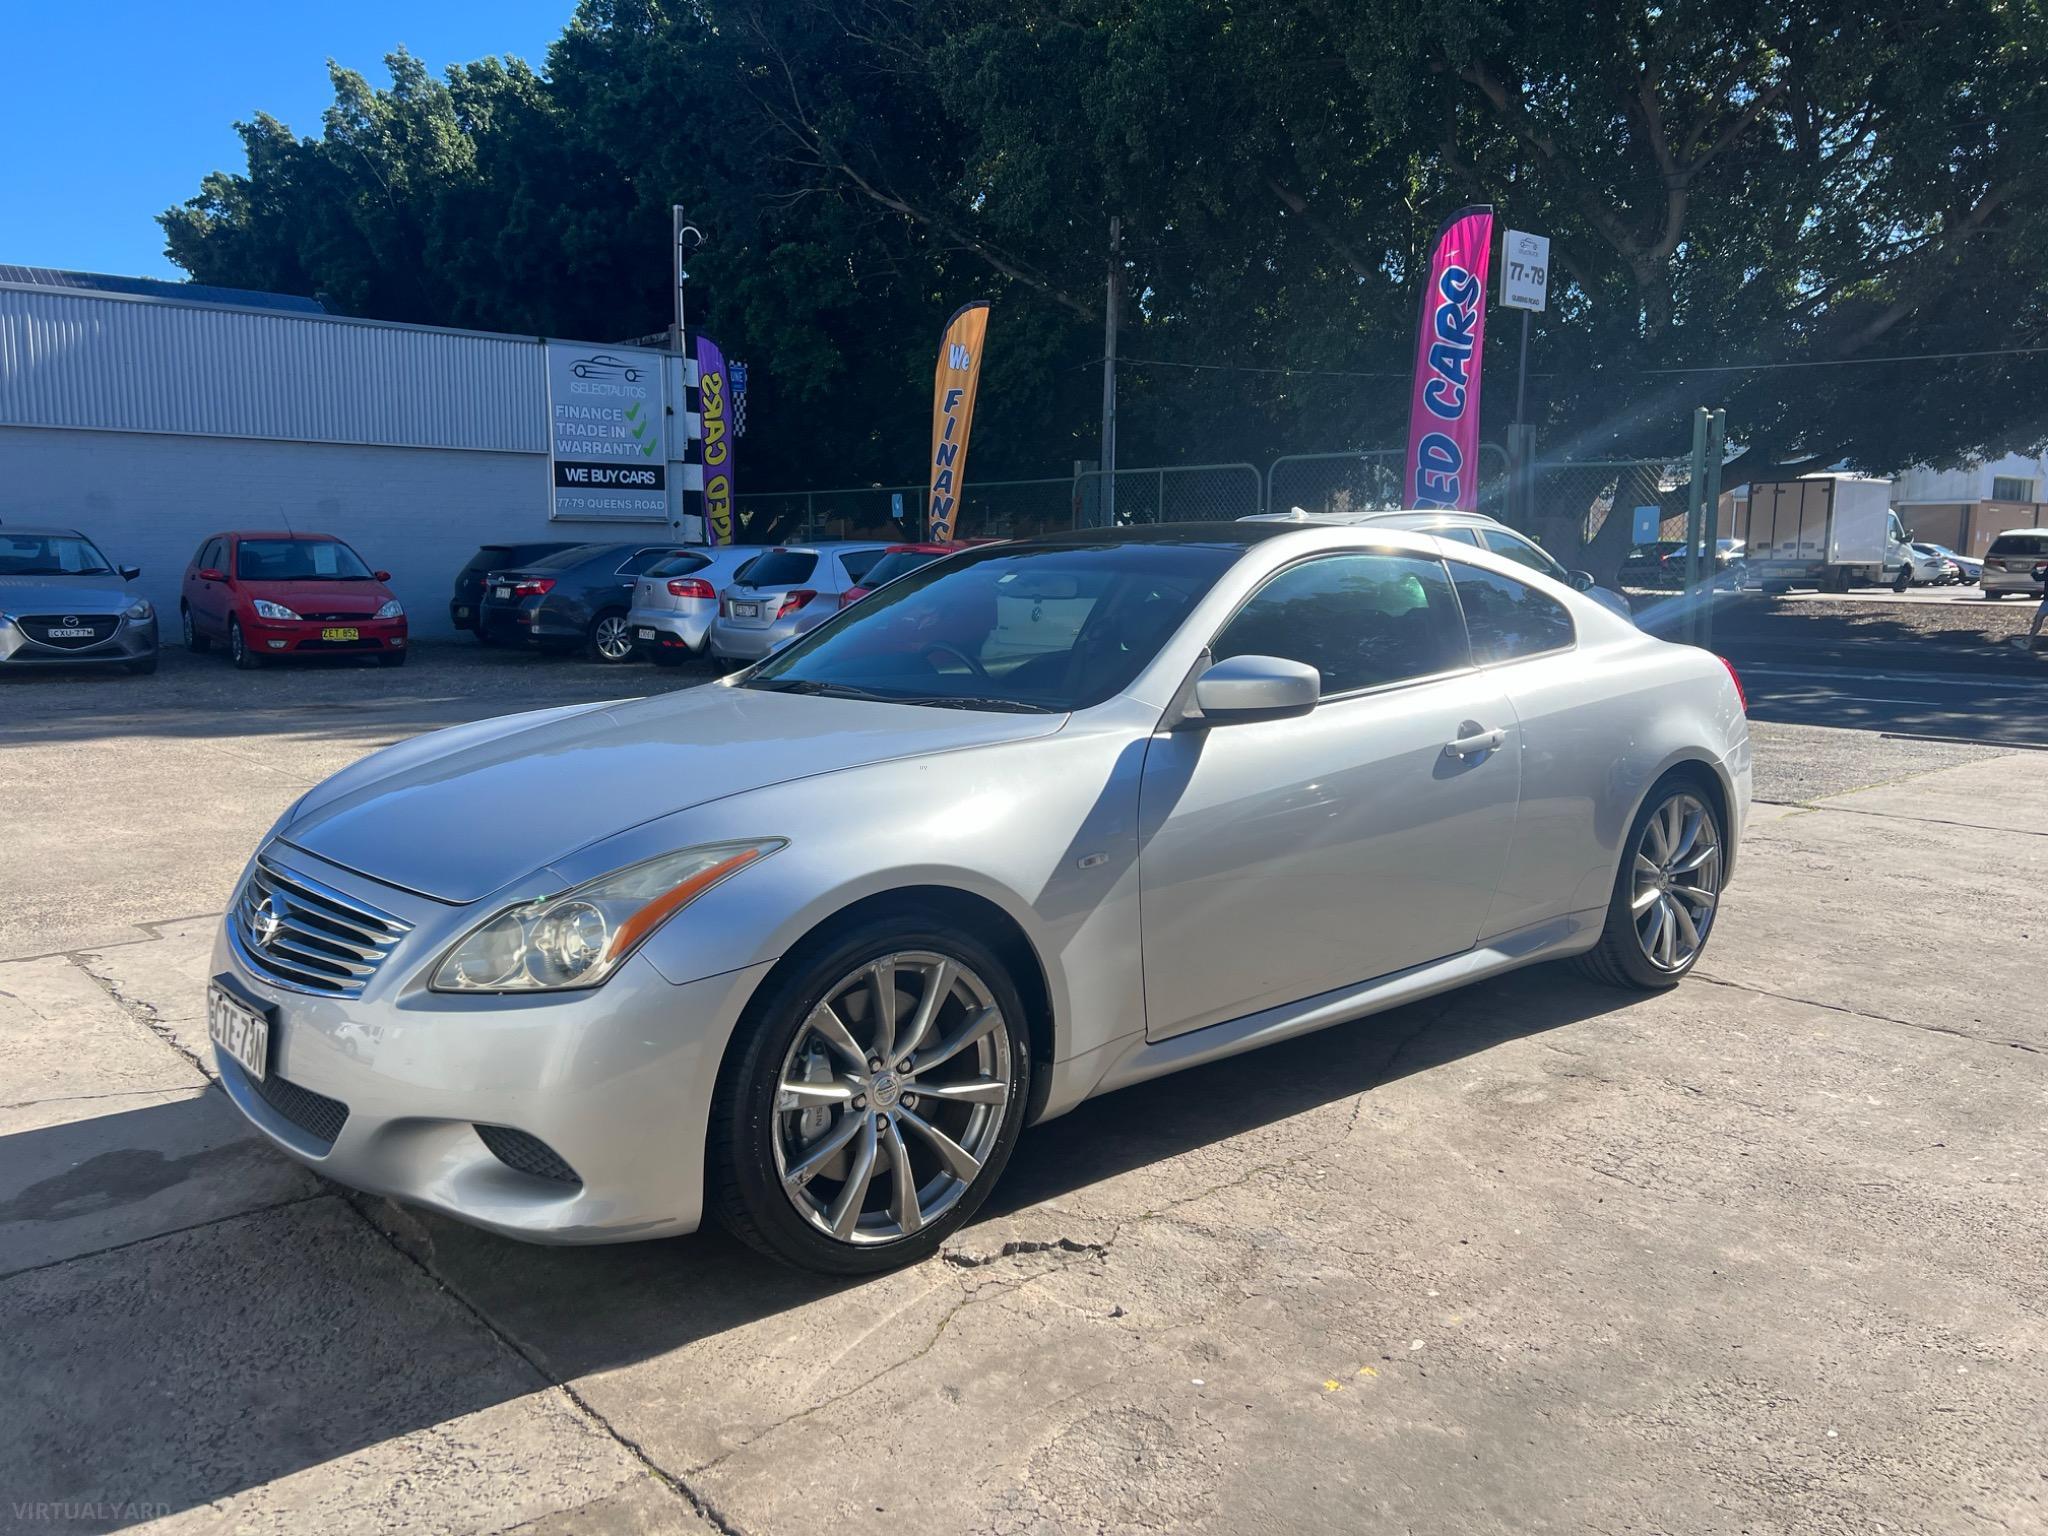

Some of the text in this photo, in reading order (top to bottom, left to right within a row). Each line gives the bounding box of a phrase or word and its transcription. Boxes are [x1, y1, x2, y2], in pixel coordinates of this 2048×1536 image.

[1510, 262, 1545, 286] 77-79
[1425, 265, 1481, 420] CARS
[949, 343, 970, 371] We
[555, 405, 622, 421] FINANCE
[556, 422, 626, 438] TRADE IN
[558, 440, 642, 456] WARRANTY
[565, 468, 656, 485] WE BUY CARS
[557, 499, 665, 510] 77-79 QUEENS ROAD
